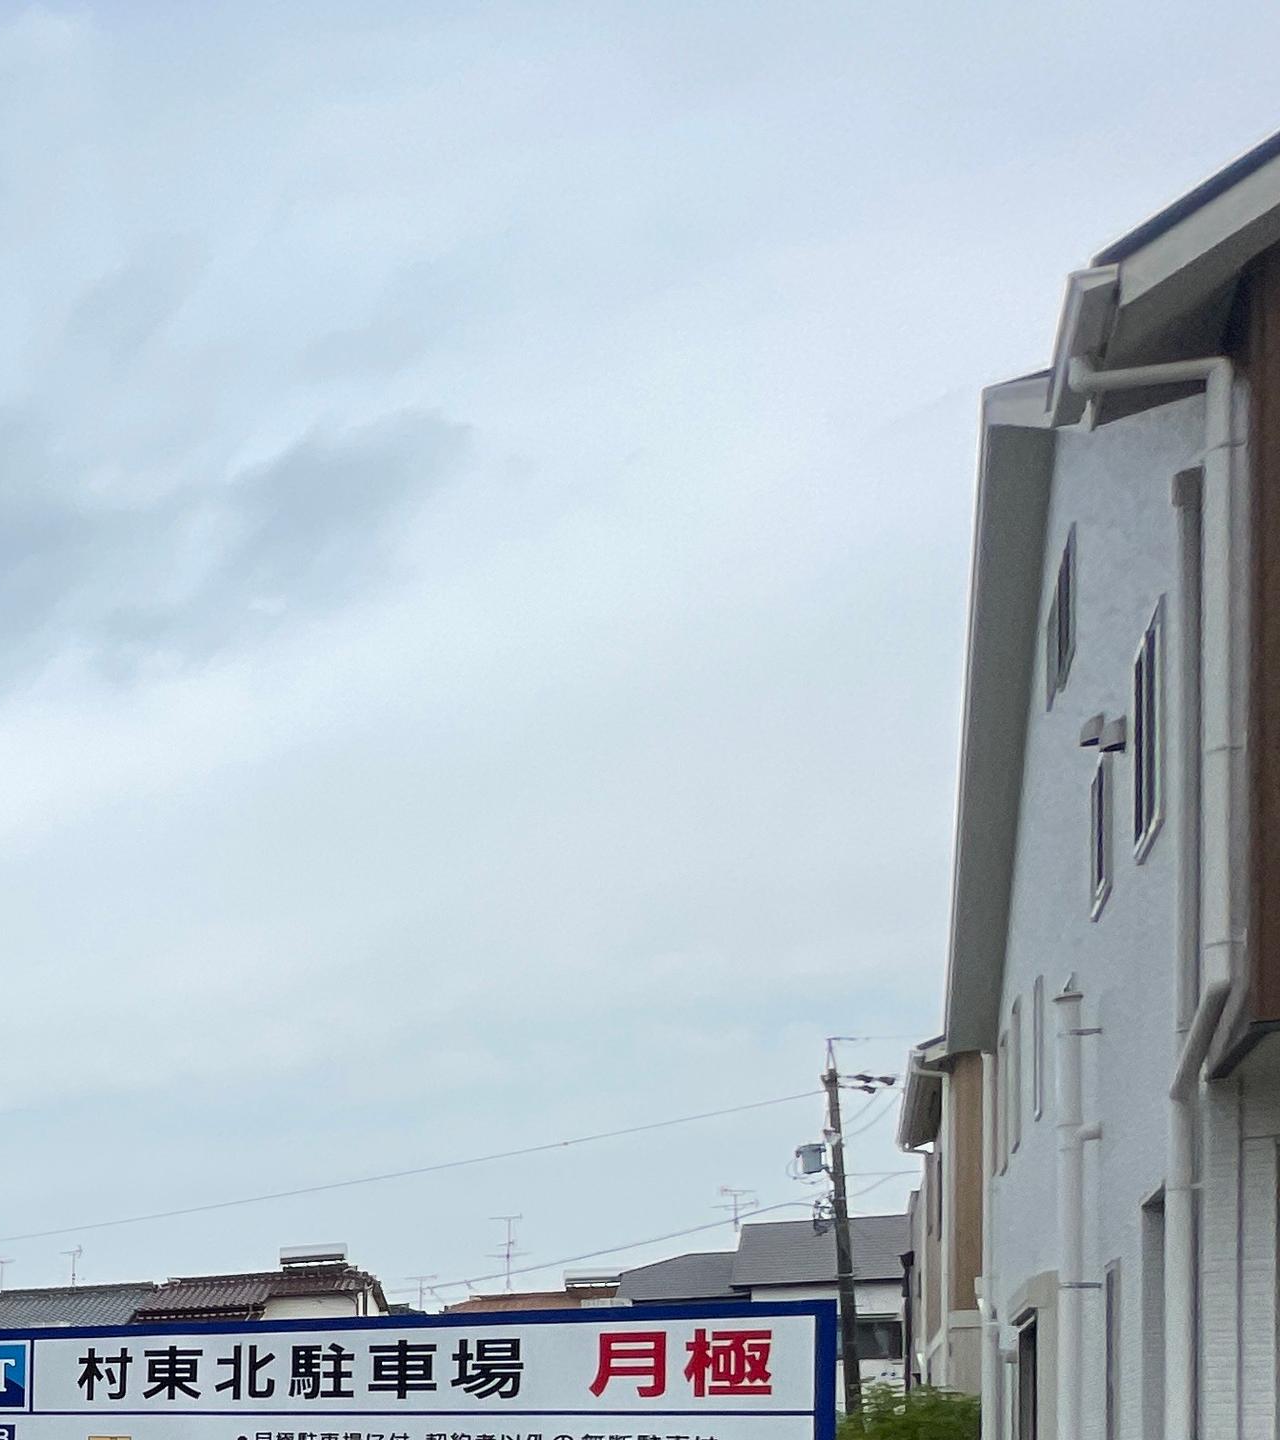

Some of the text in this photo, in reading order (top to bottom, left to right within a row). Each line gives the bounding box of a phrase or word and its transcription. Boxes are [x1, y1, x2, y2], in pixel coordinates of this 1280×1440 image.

[77, 1328, 773, 1400] 村東北駐車場 月極
